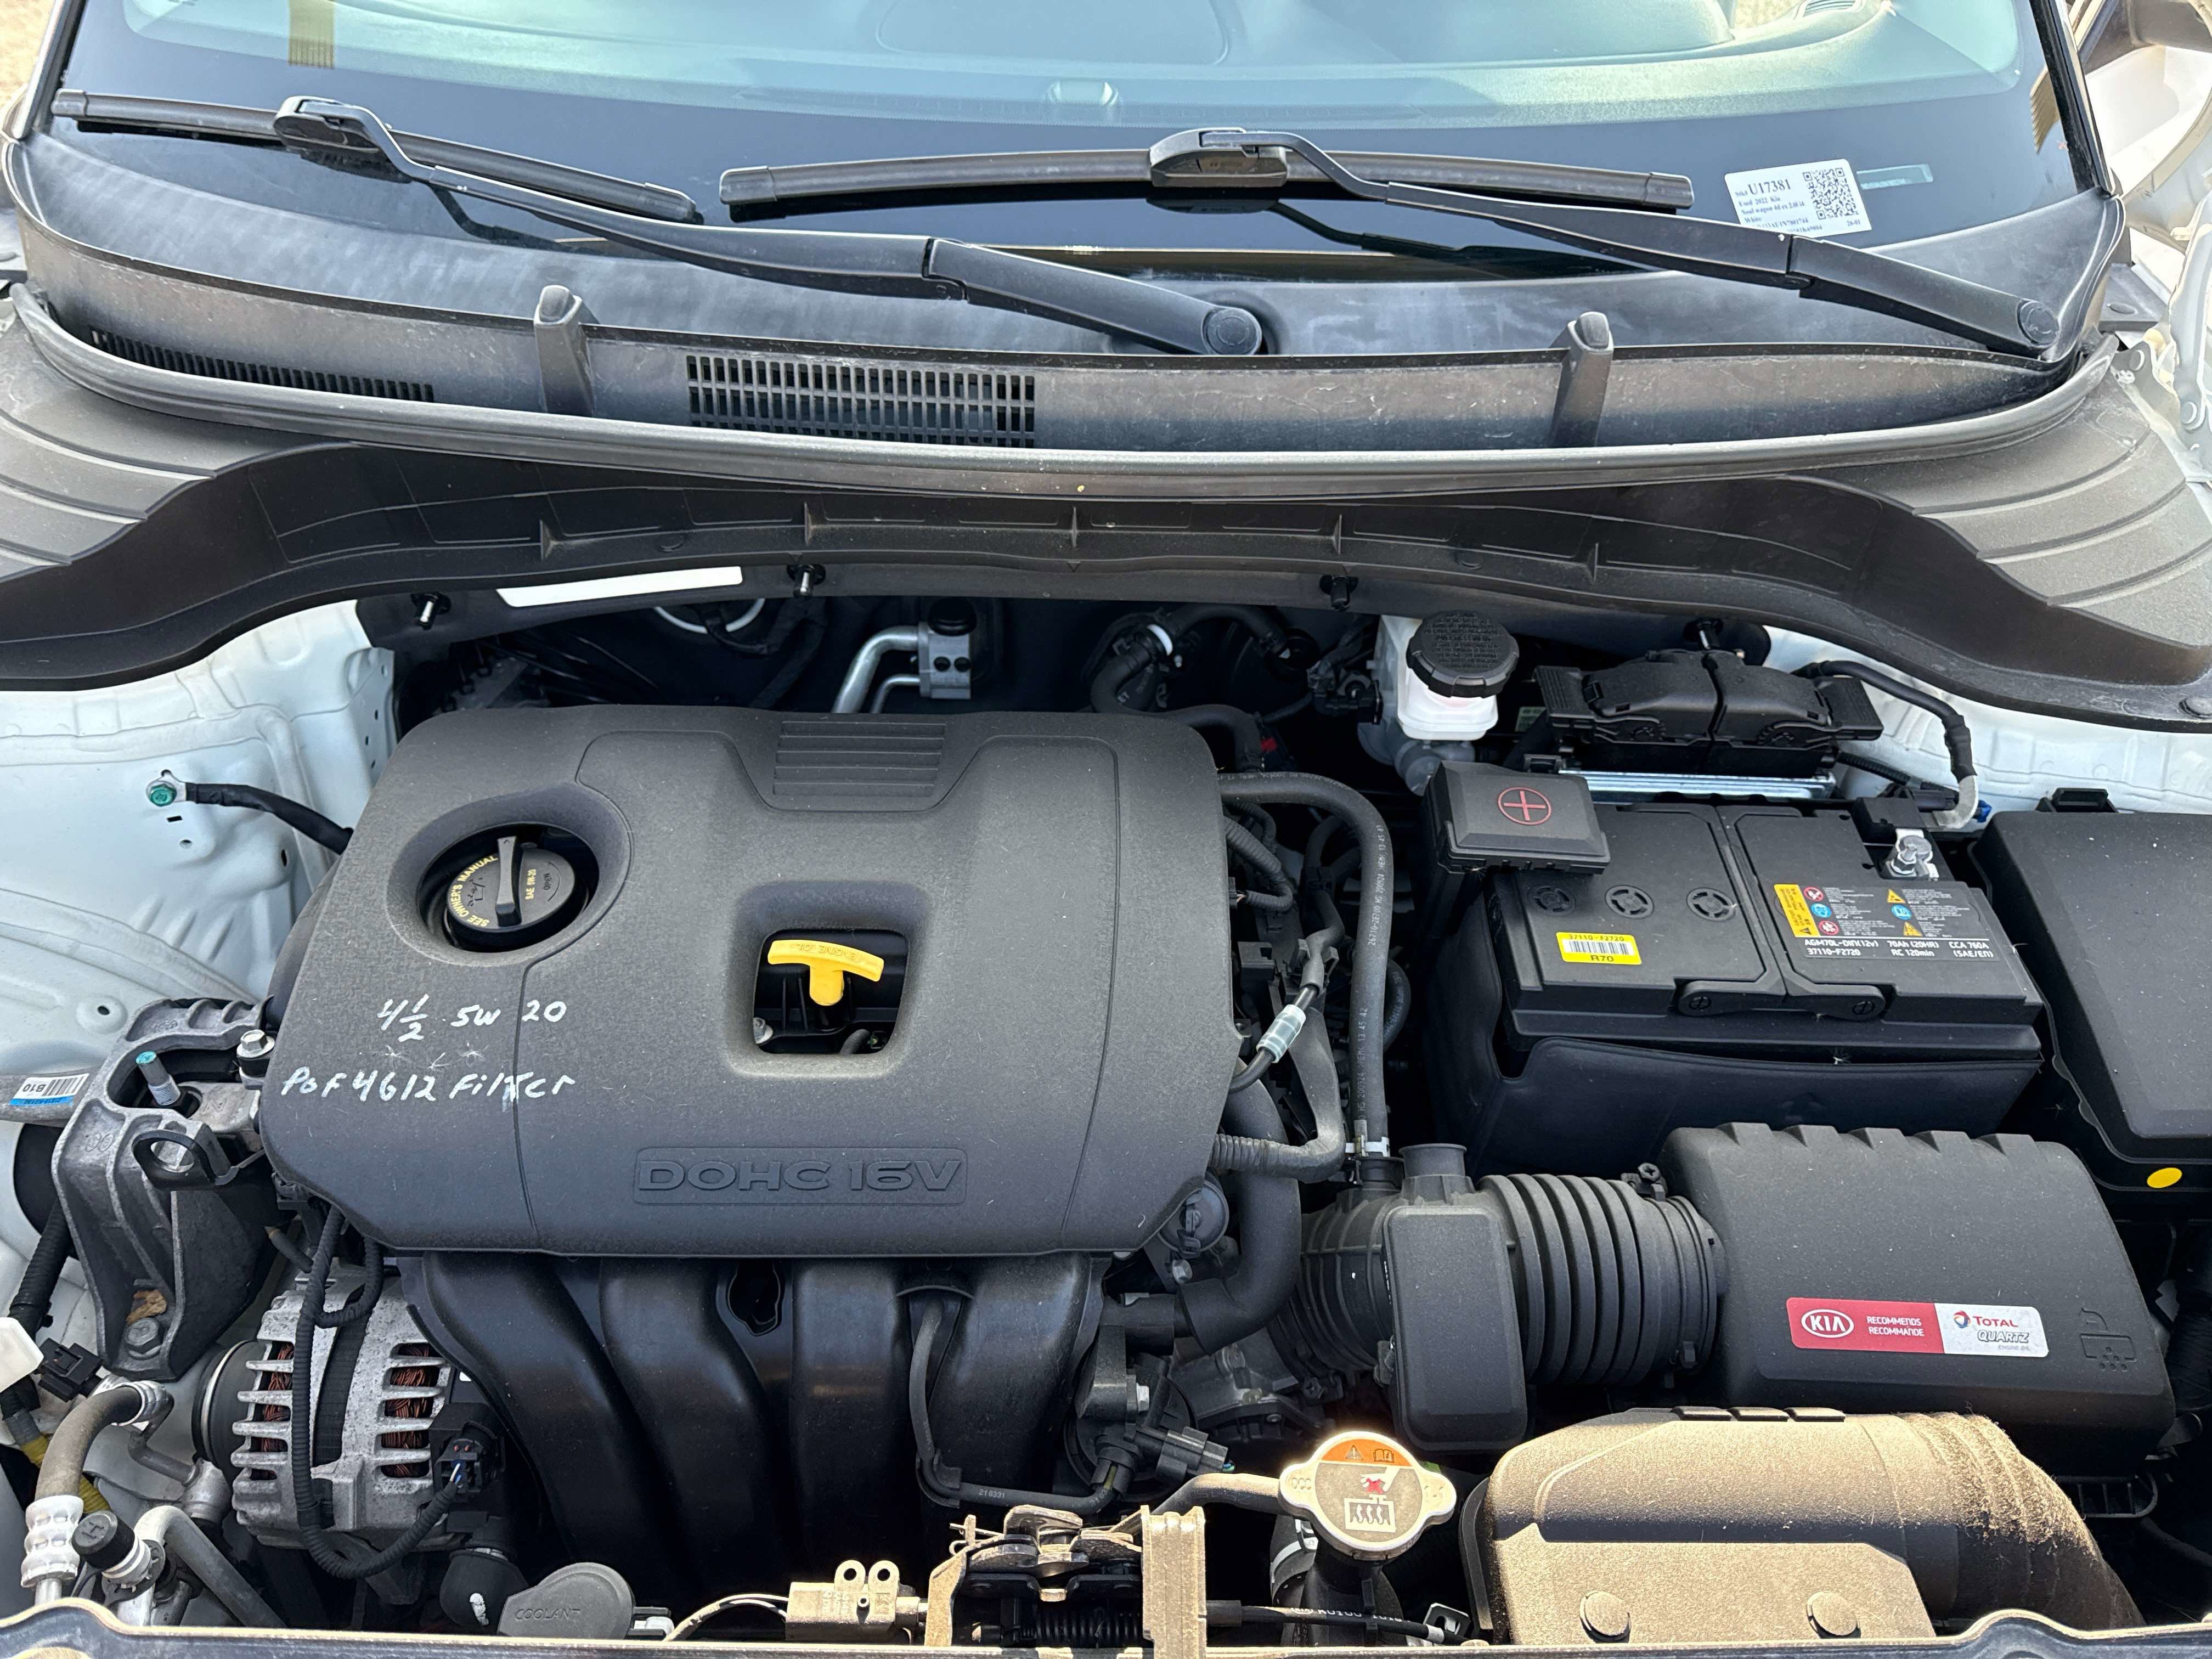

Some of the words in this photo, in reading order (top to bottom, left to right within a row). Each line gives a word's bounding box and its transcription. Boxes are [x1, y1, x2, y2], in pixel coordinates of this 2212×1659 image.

[1748, 179, 1791, 195] U17381
[457, 854, 498, 882] MANUAL
[525, 885, 535, 900] SAE
[450, 884, 470, 918] OWNER'S
[467, 914, 490, 928] SEE
[1807, 947, 1861, 956] 37110-F2720
[521, 1000, 567, 1023] 20
[22, 1084, 47, 1092] B10
[637, 1160, 831, 1192] DOHC
[850, 1160, 962, 1192] 16V
[1810, 1315, 1847, 1332] KIA
[1866, 1316, 1922, 1326] RECOMMENDS
[1973, 1316, 2018, 1328] TOTAL
[1869, 1326, 1925, 1336] RECOMMANDE
[1977, 1329, 2030, 1344] QUARTZ
[978, 1488, 1005, 1499] 210331
[515, 1608, 581, 1620] COOLANT
